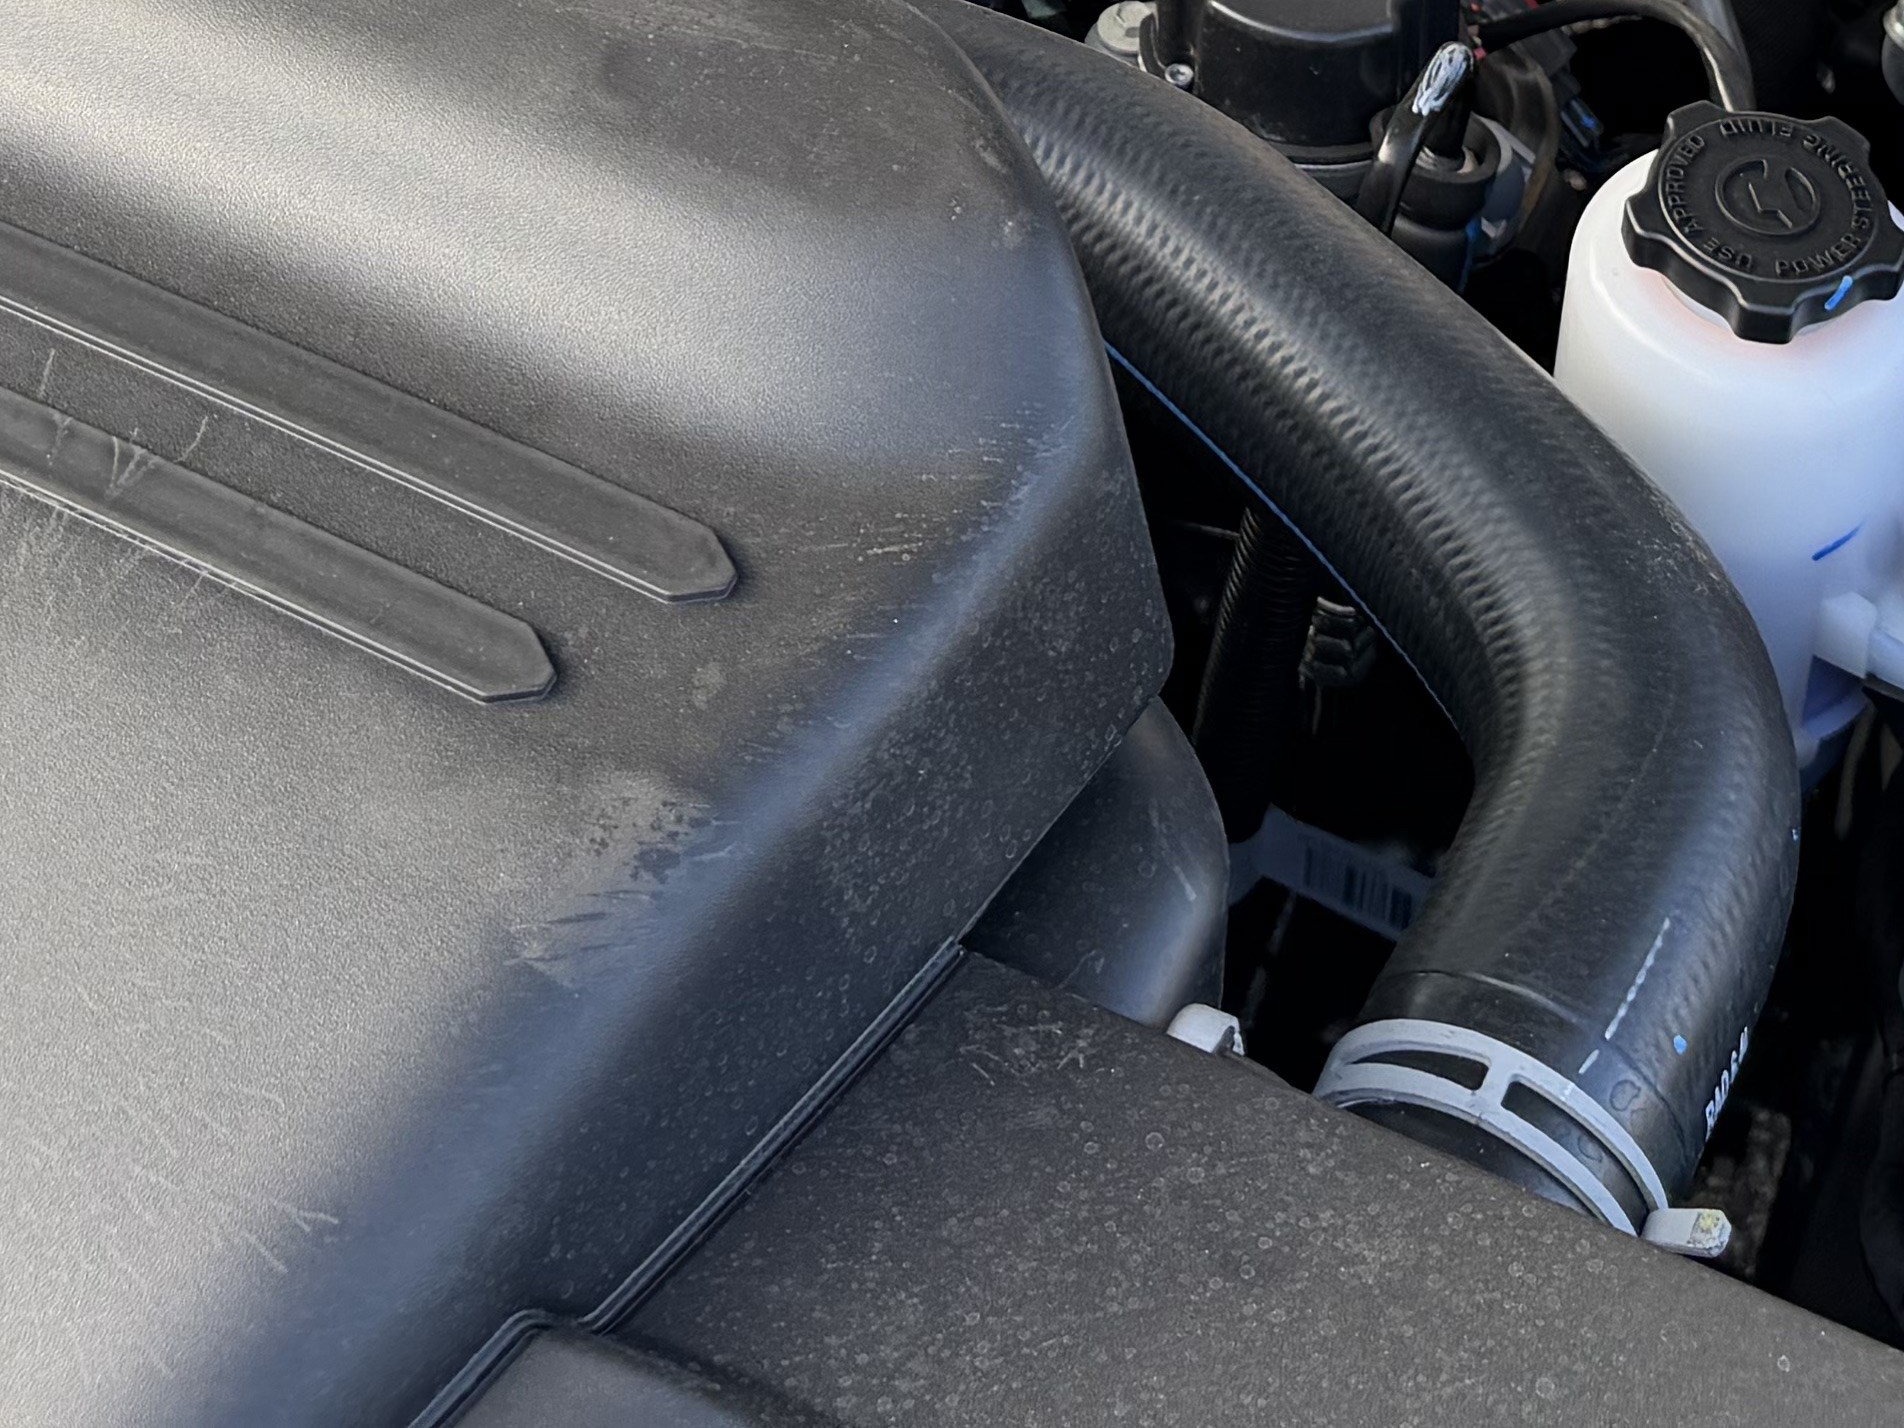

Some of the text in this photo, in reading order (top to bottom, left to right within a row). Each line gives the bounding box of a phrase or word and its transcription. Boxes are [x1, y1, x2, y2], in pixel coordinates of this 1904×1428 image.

[1665, 134, 1753, 270] USE APPROVED
[1719, 118, 1874, 276] POWER STEERING FLUID
